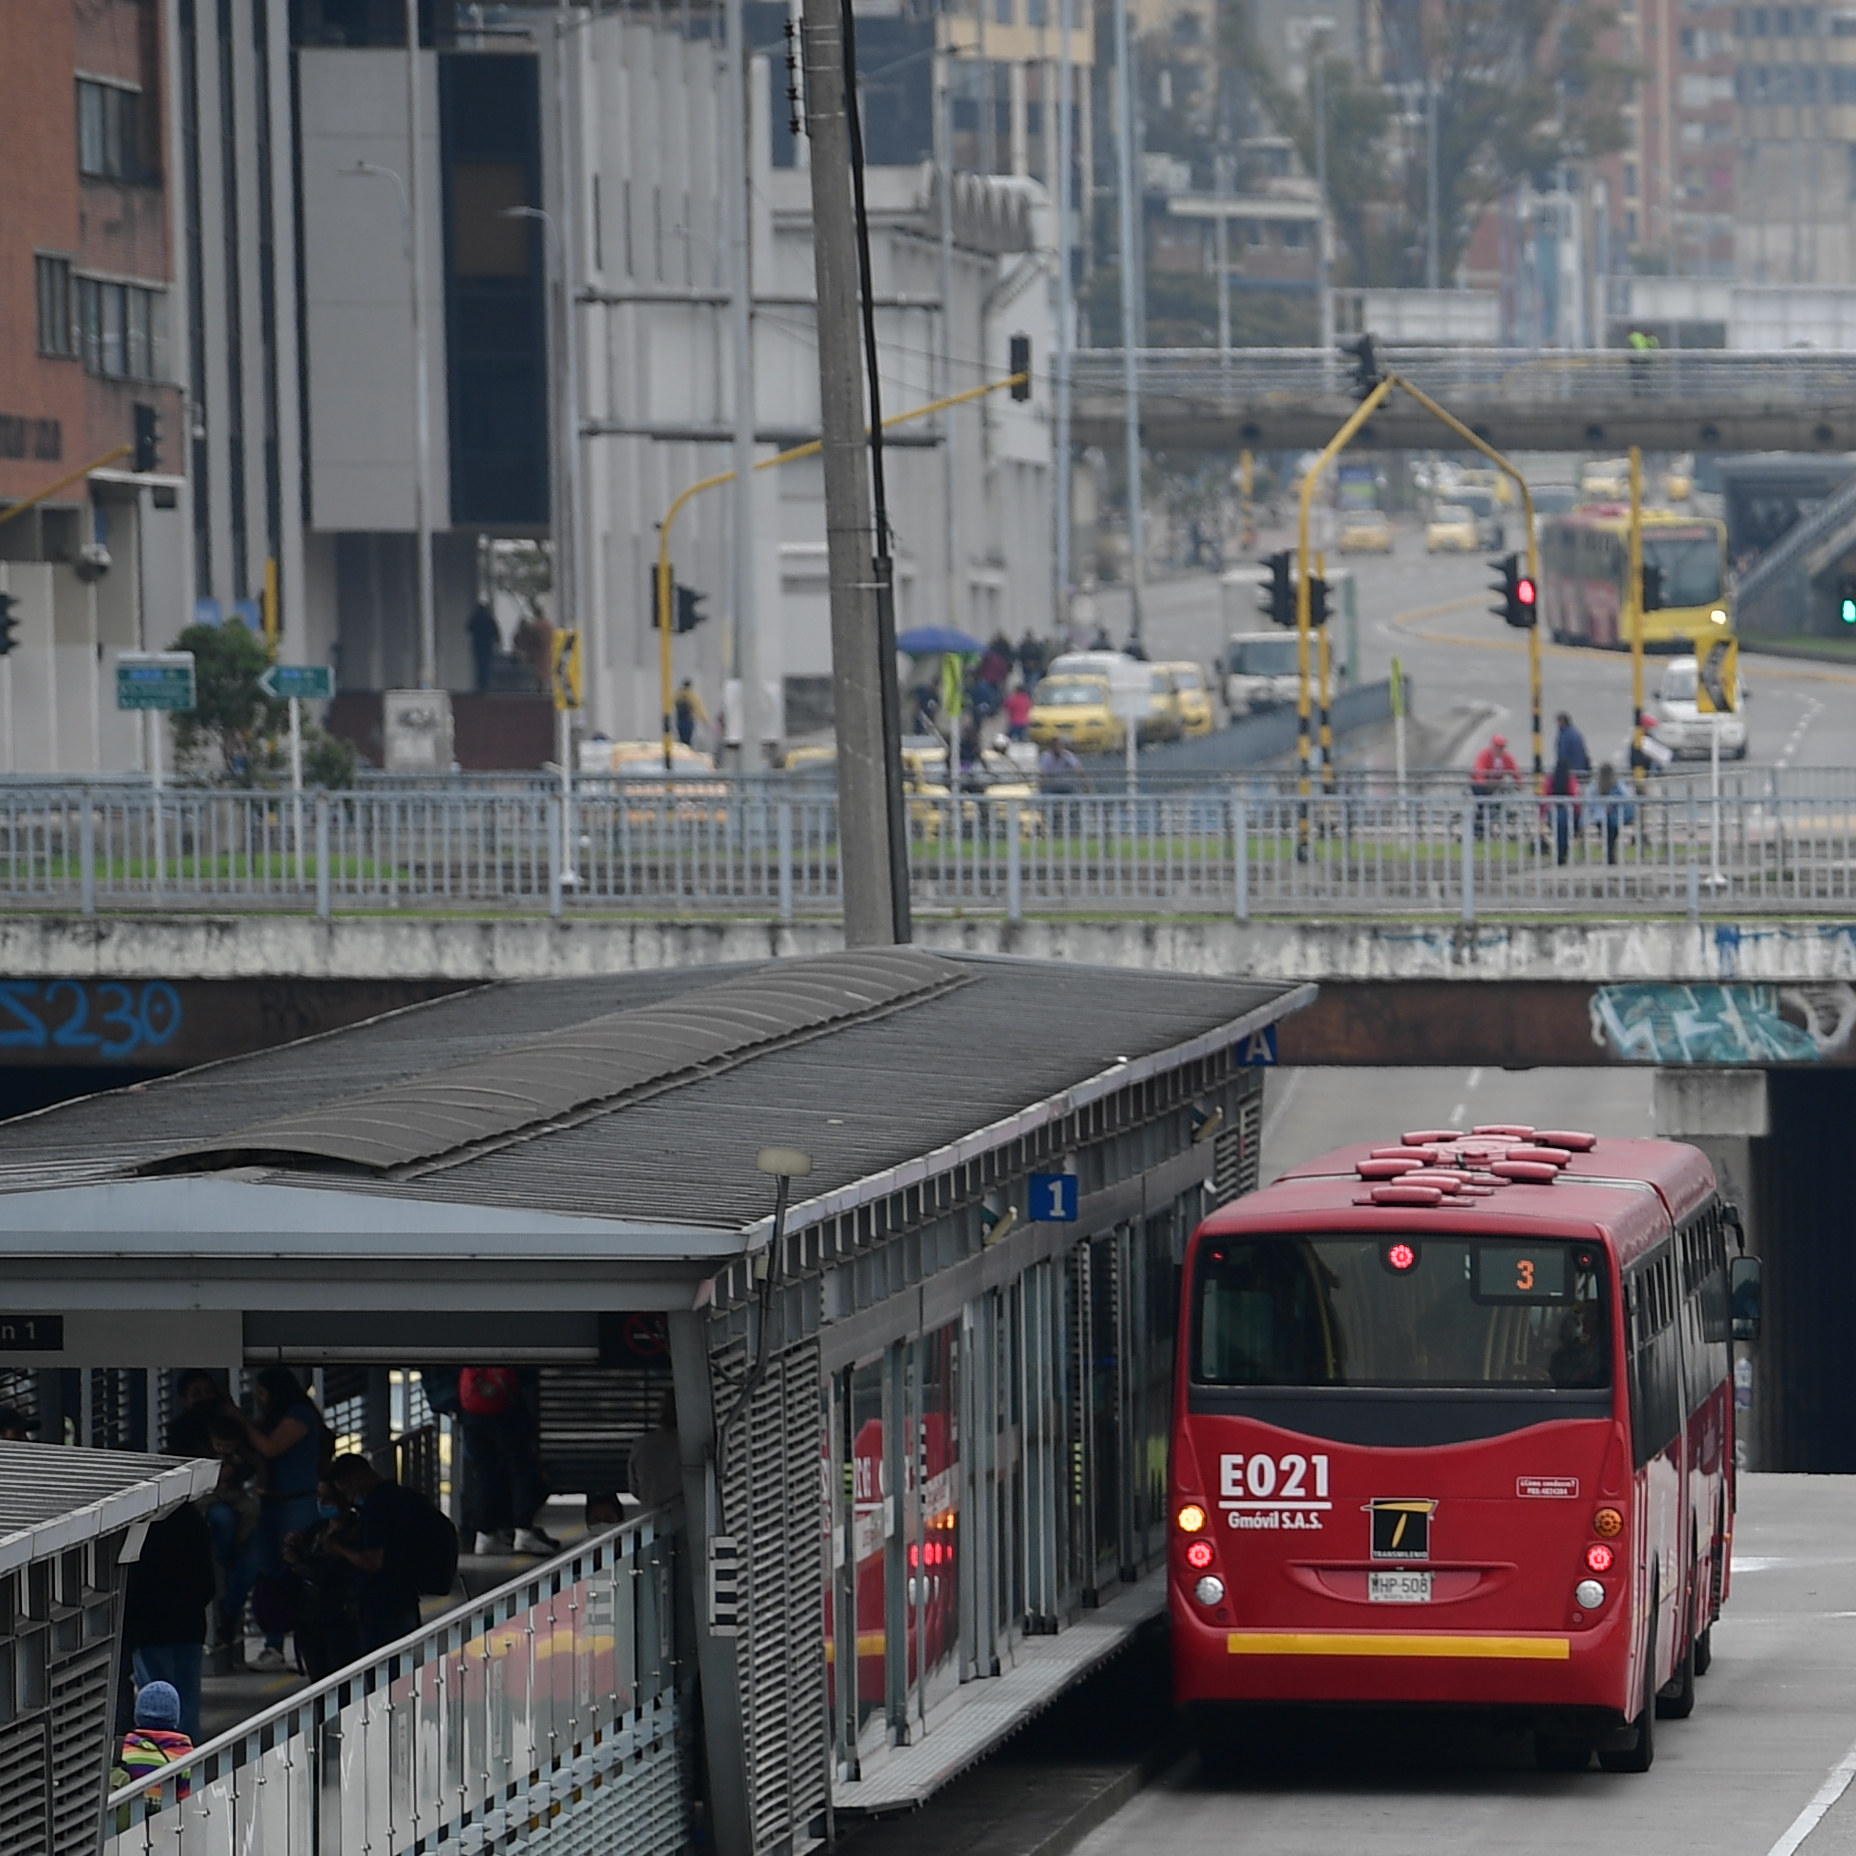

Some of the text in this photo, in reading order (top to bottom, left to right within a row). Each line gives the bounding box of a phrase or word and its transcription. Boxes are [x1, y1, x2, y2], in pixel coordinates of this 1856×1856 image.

[1048, 1180, 1066, 1216] 1
[1516, 1259, 1534, 1290] 3
[1220, 1454, 1329, 1497] E021
[1228, 1511, 1323, 1529] Gmóvil S.A.S.
